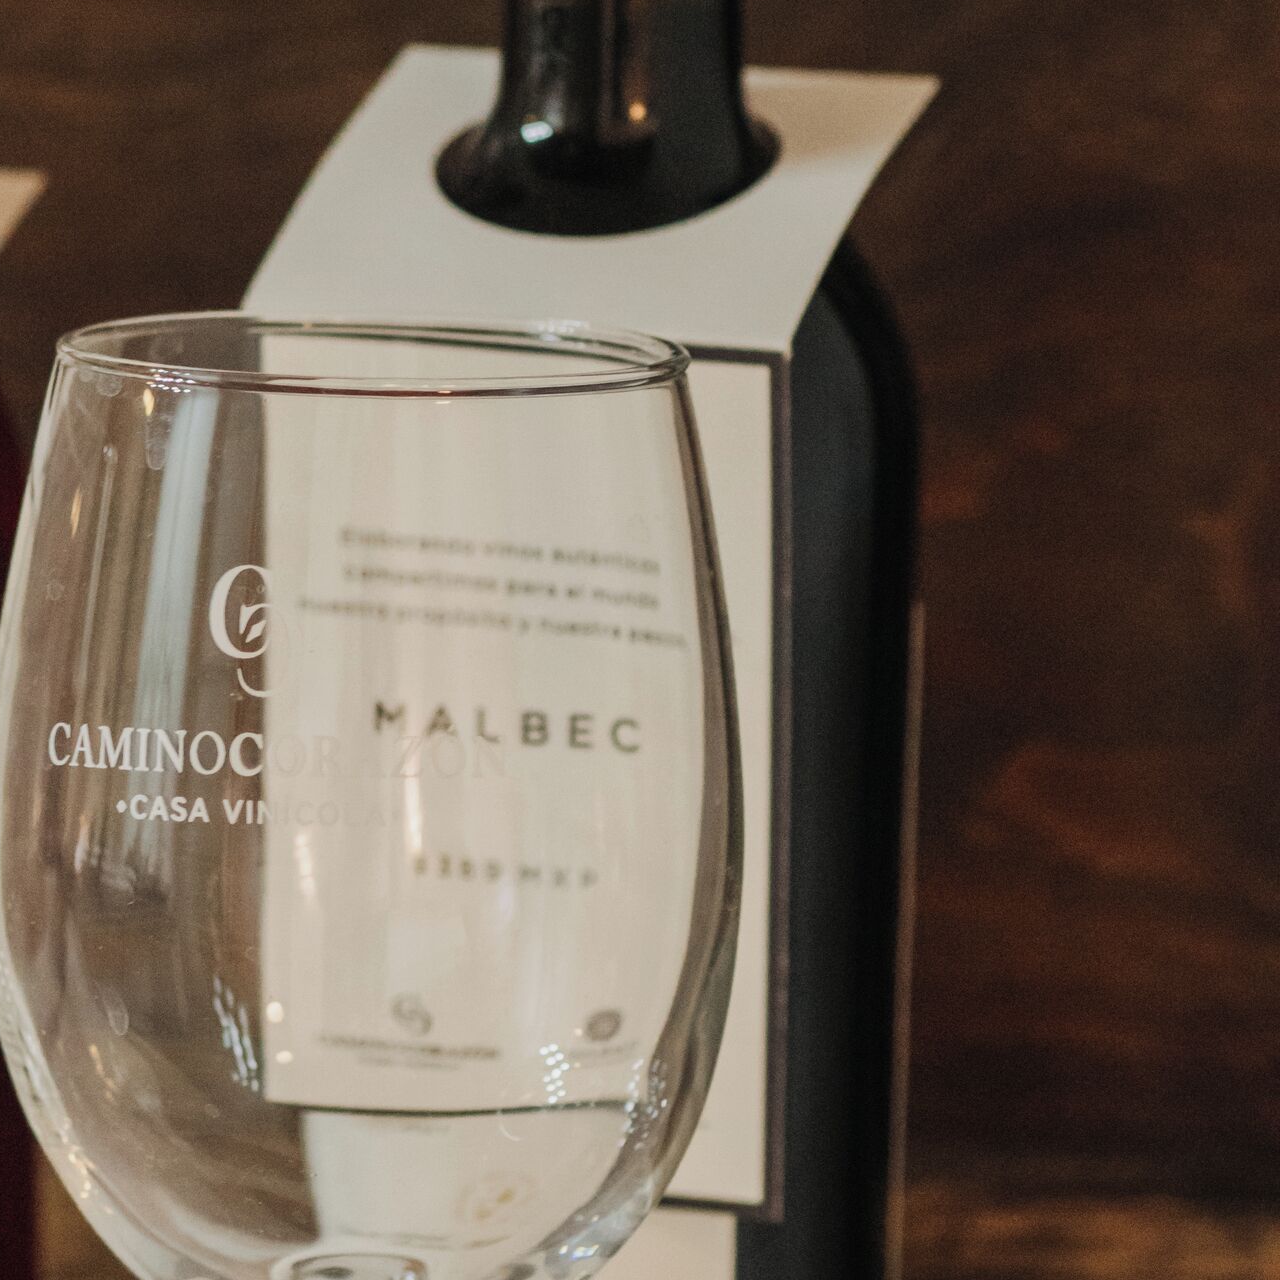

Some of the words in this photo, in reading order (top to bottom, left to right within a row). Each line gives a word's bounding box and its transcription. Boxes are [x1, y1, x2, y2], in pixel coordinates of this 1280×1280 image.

[48, 721, 508, 779] CAMINOCORZÓN
[373, 700, 642, 754] MALBEC
[129, 794, 210, 824] CASA
